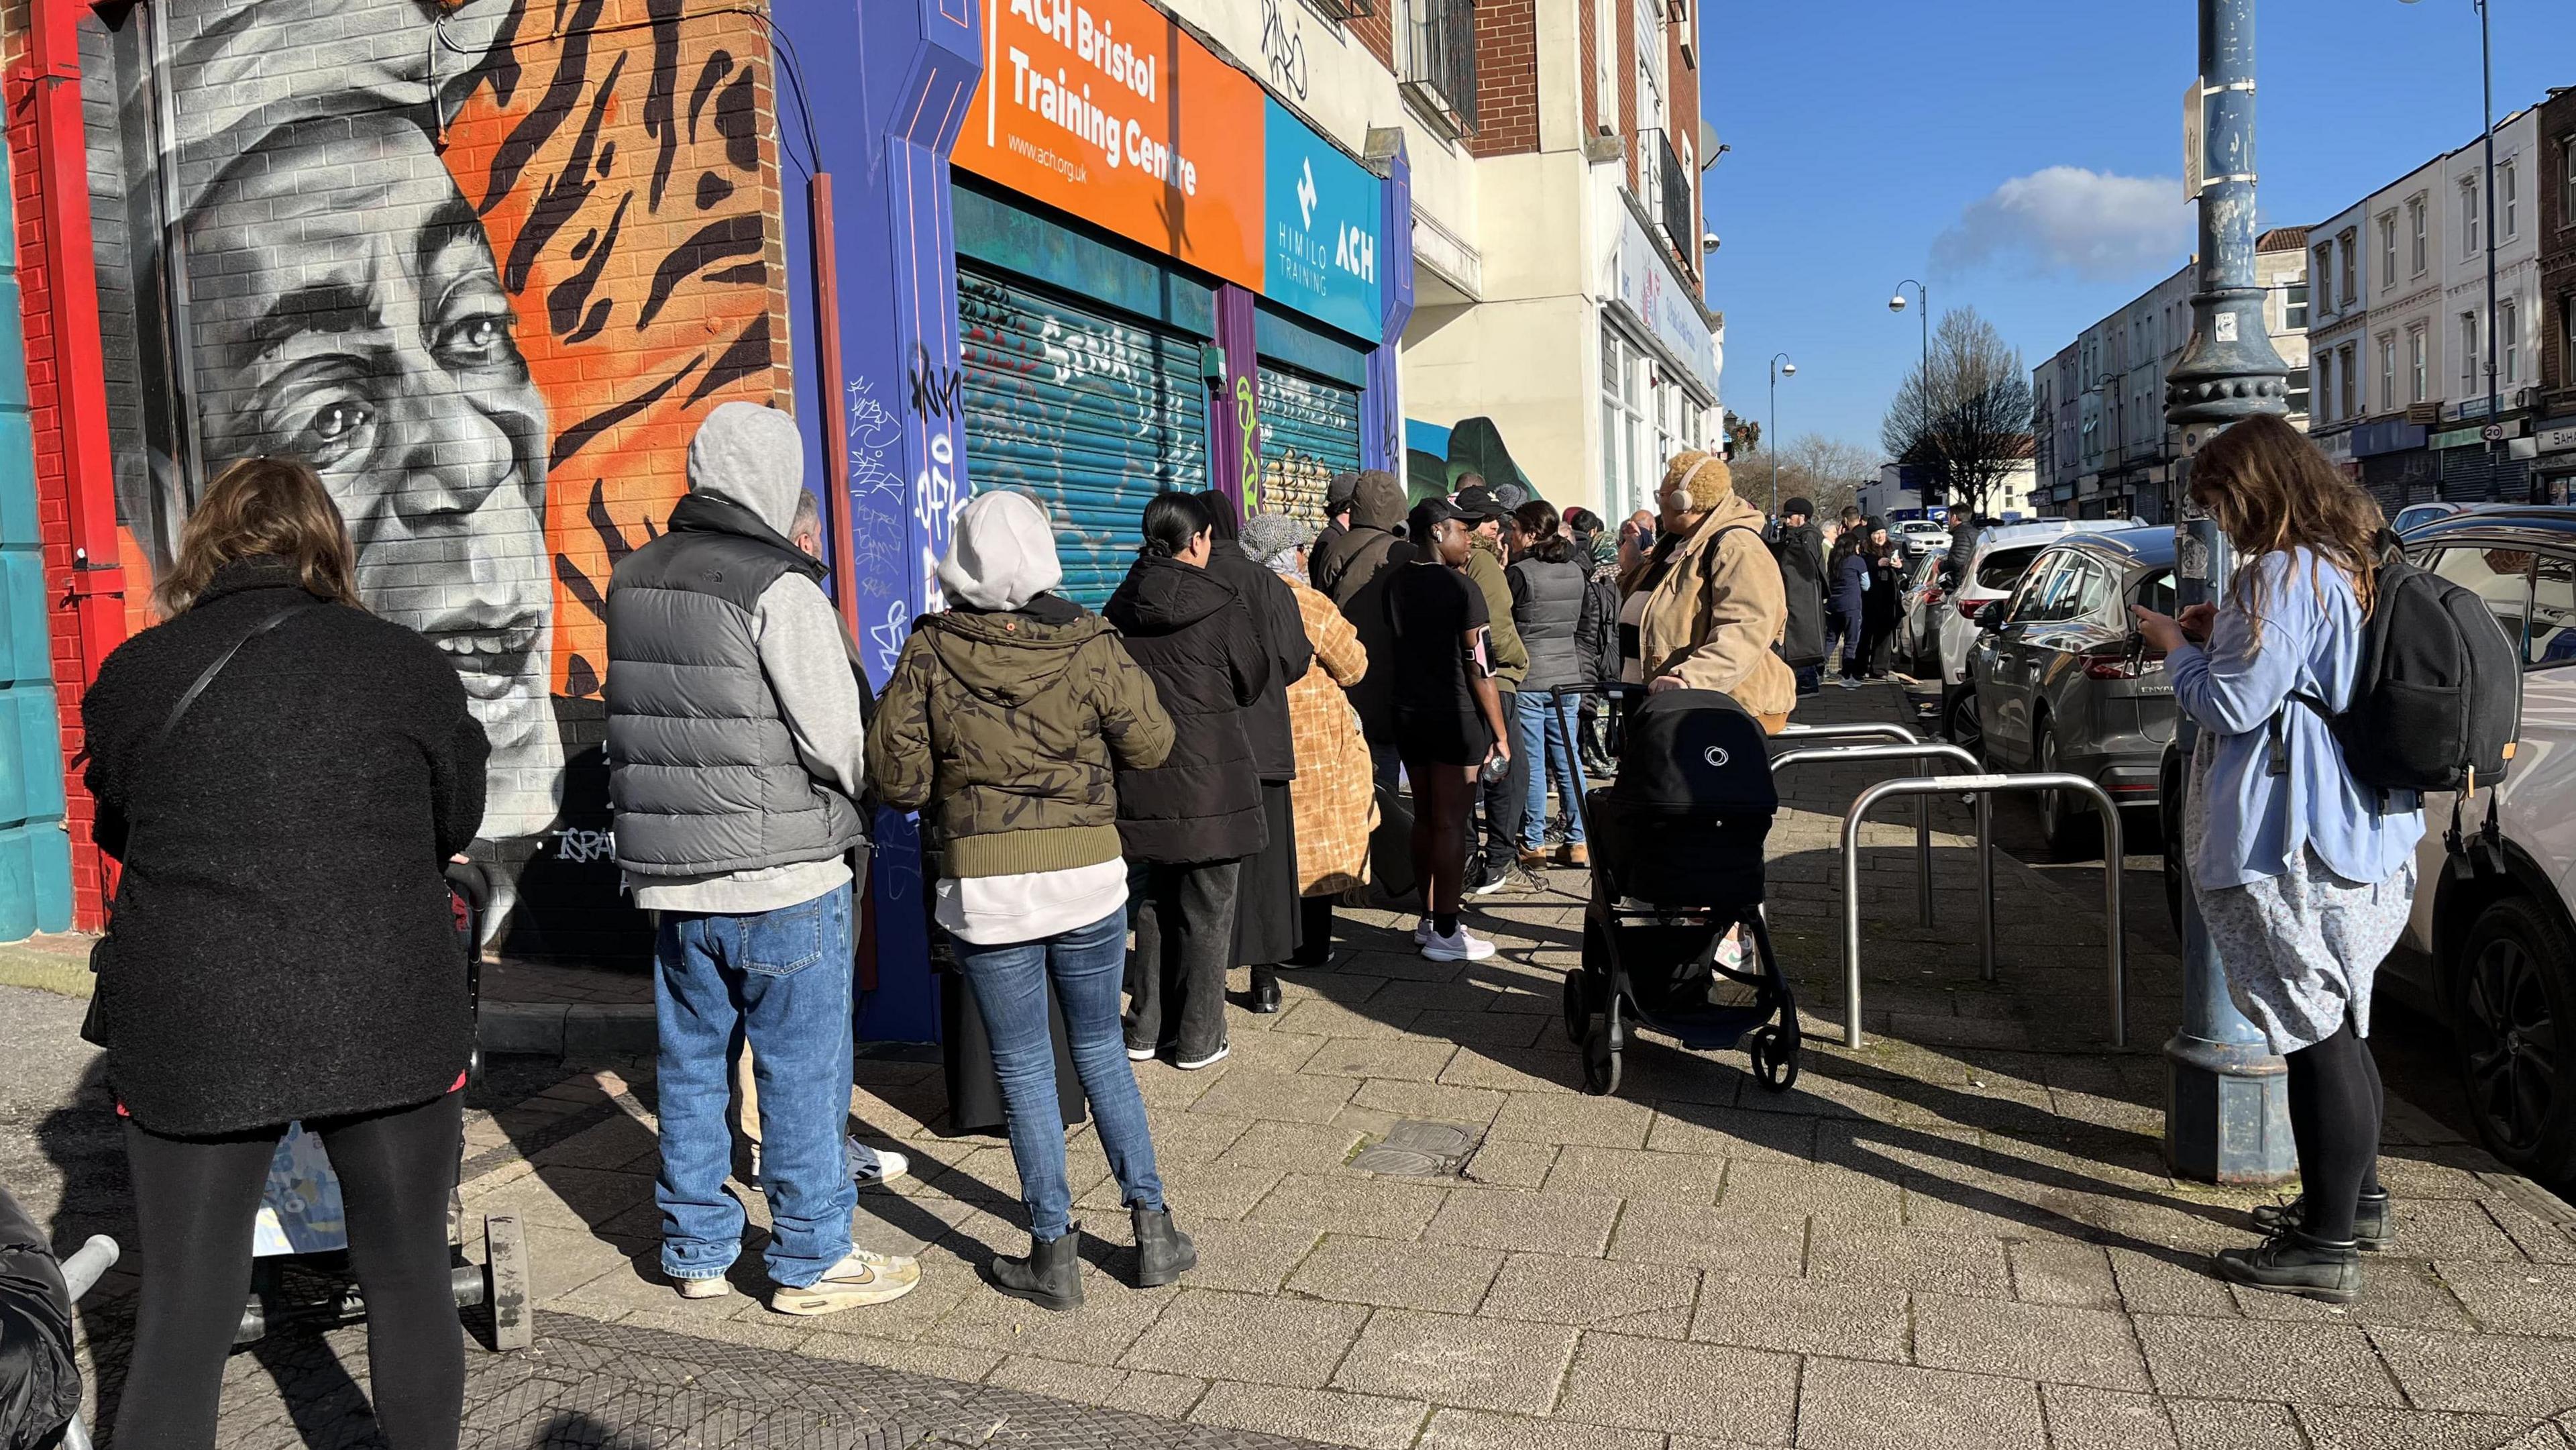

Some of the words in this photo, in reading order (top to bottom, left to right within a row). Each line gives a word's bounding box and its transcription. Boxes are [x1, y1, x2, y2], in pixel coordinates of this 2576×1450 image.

[1077, 6, 1155, 103] Bristol
[1009, 46, 1120, 168] Training
[1125, 118, 1197, 197] Centre
[1008, 134, 1087, 184] www.ach.org.uk
[1279, 221, 1326, 270] HIMILO
[1335, 219, 1373, 284] ACH
[1279, 254, 1326, 297] TRAINING
[2486, 429, 2500, 437] 20
